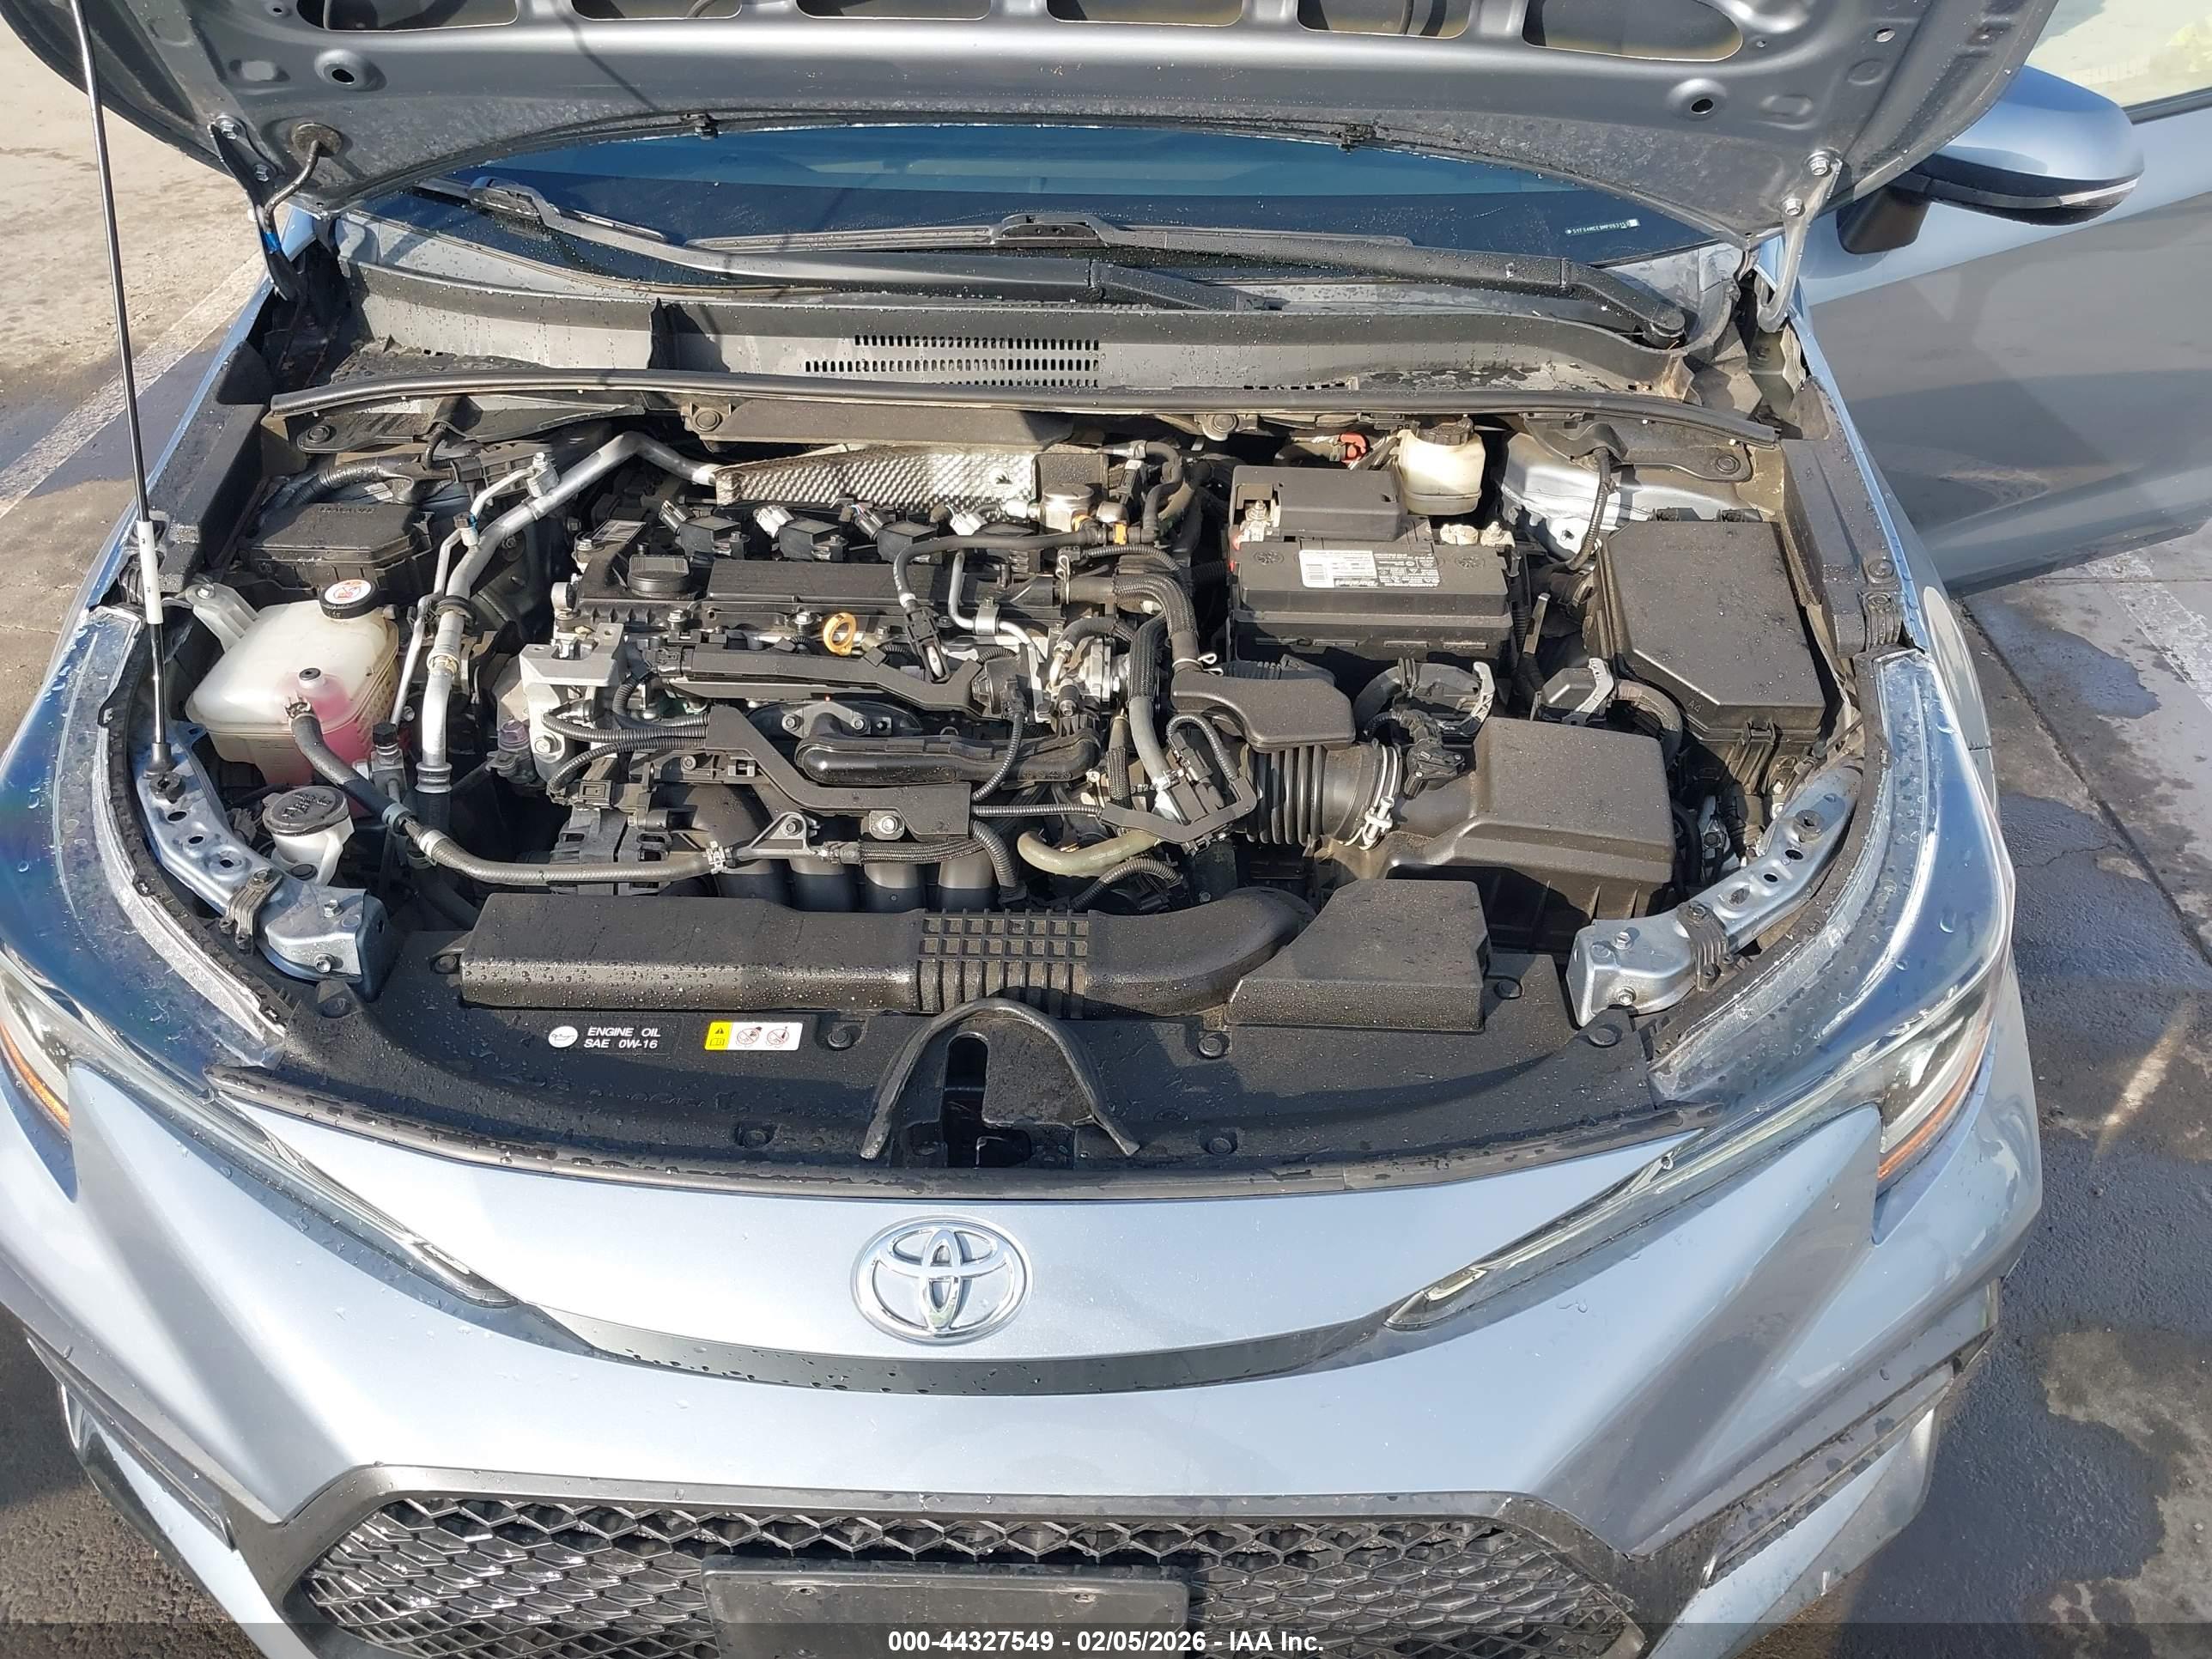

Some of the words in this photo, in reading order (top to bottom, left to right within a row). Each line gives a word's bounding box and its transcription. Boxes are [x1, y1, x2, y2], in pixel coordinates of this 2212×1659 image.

[586, 1027, 634, 1036] ENGINE
[641, 1027, 661, 1037] OIL
[584, 1039, 611, 1048] SAE
[618, 1039, 658, 1048] 0W-16
